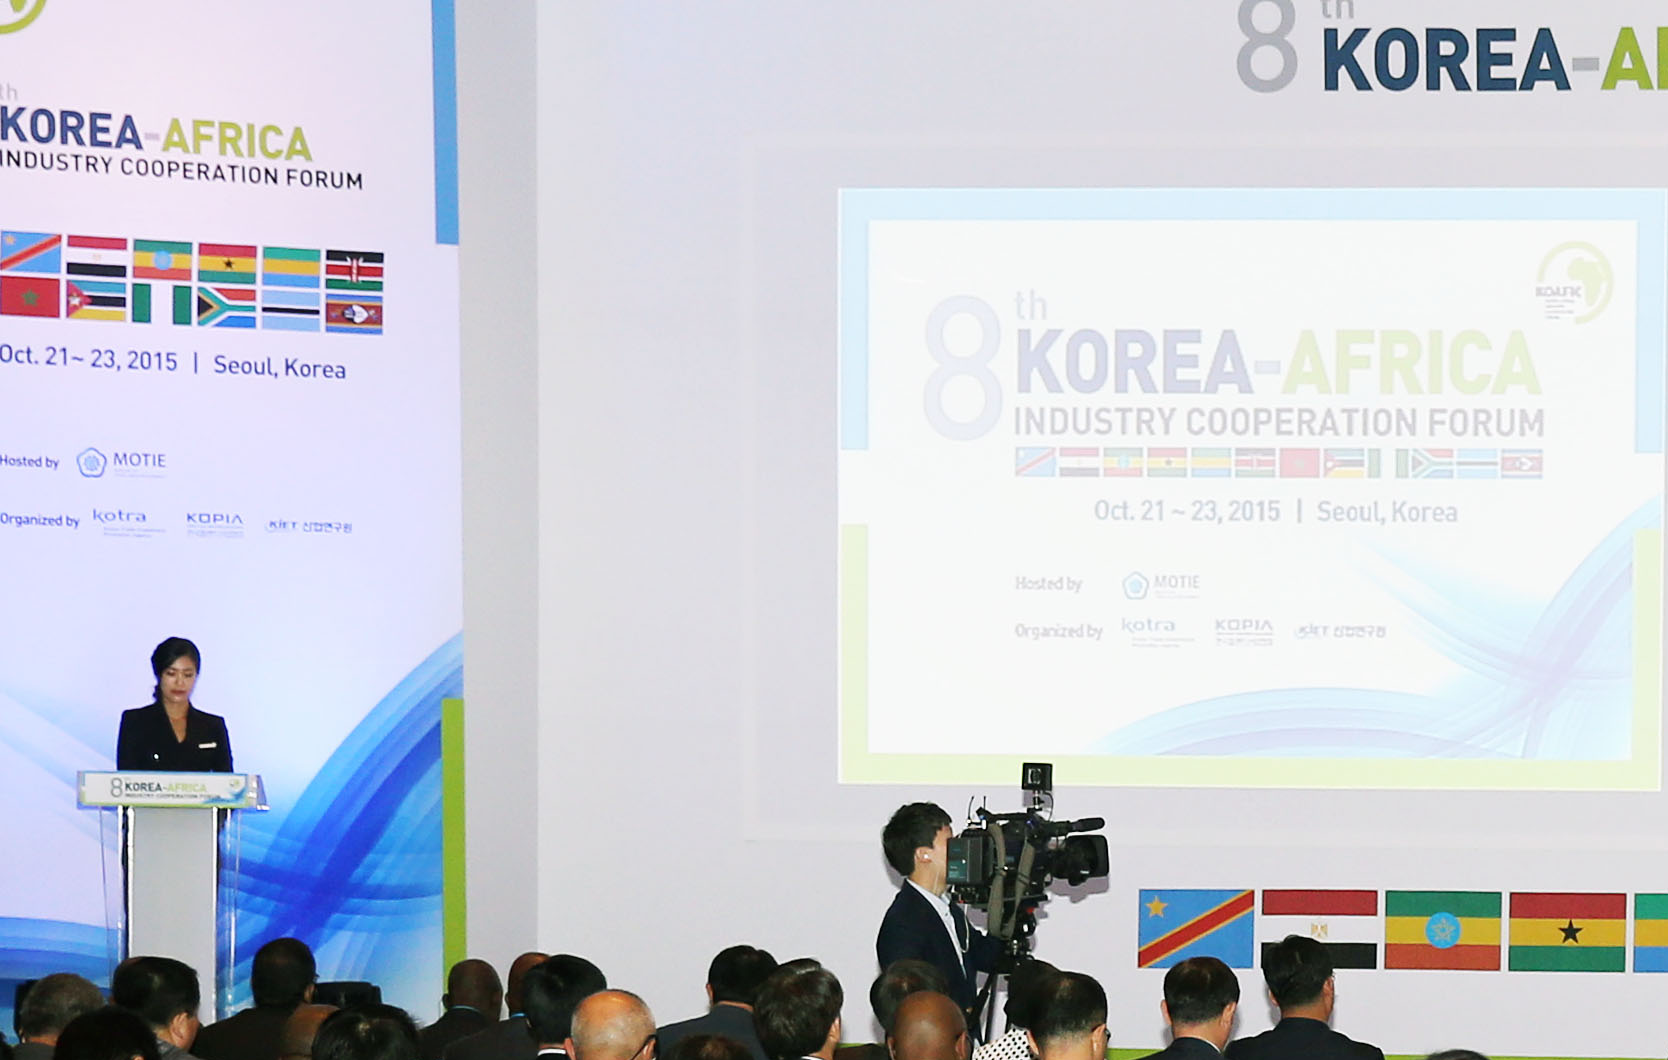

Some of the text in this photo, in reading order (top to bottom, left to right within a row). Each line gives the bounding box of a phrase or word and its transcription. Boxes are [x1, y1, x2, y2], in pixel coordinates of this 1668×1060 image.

[1237, 0, 1299, 93] 8
[0, 105, 363, 190] KOREA-AFRICA INDUSTRY COOPERATION FORUM
[0, 344, 38, 364] Oct.
[91, 349, 121, 370] 23,
[127, 351, 178, 371] 2015
[214, 355, 279, 379] Seoul,
[285, 357, 347, 379] Korea
[924, 288, 1047, 441] 8 th
[1016, 329, 1544, 395] KOREA-AFRICA
[1014, 407, 1546, 438] INDUSTRY COOPERATION FORUM
[0, 452, 166, 470] Hosted by MOTIE
[0, 512, 63, 528] Organized
[66, 514, 80, 529] by
[93, 509, 147, 523] kotra
[186, 513, 244, 524] KOPIA
[1094, 500, 1135, 521] Oct.
[1141, 500, 1165, 521] 21
[1191, 501, 1223, 525] 23,
[1228, 501, 1281, 521] 2015
[1317, 502, 1386, 526] Seoul,
[1391, 502, 1459, 522] Korea
[1015, 575, 1200, 593] Hosted by MOTIE
[1015, 623, 1084, 641] Organized
[1087, 624, 1103, 641] by
[1121, 617, 1175, 633] kotra
[1215, 619, 1273, 631] KOPIA
[111, 777, 123, 798] 8
